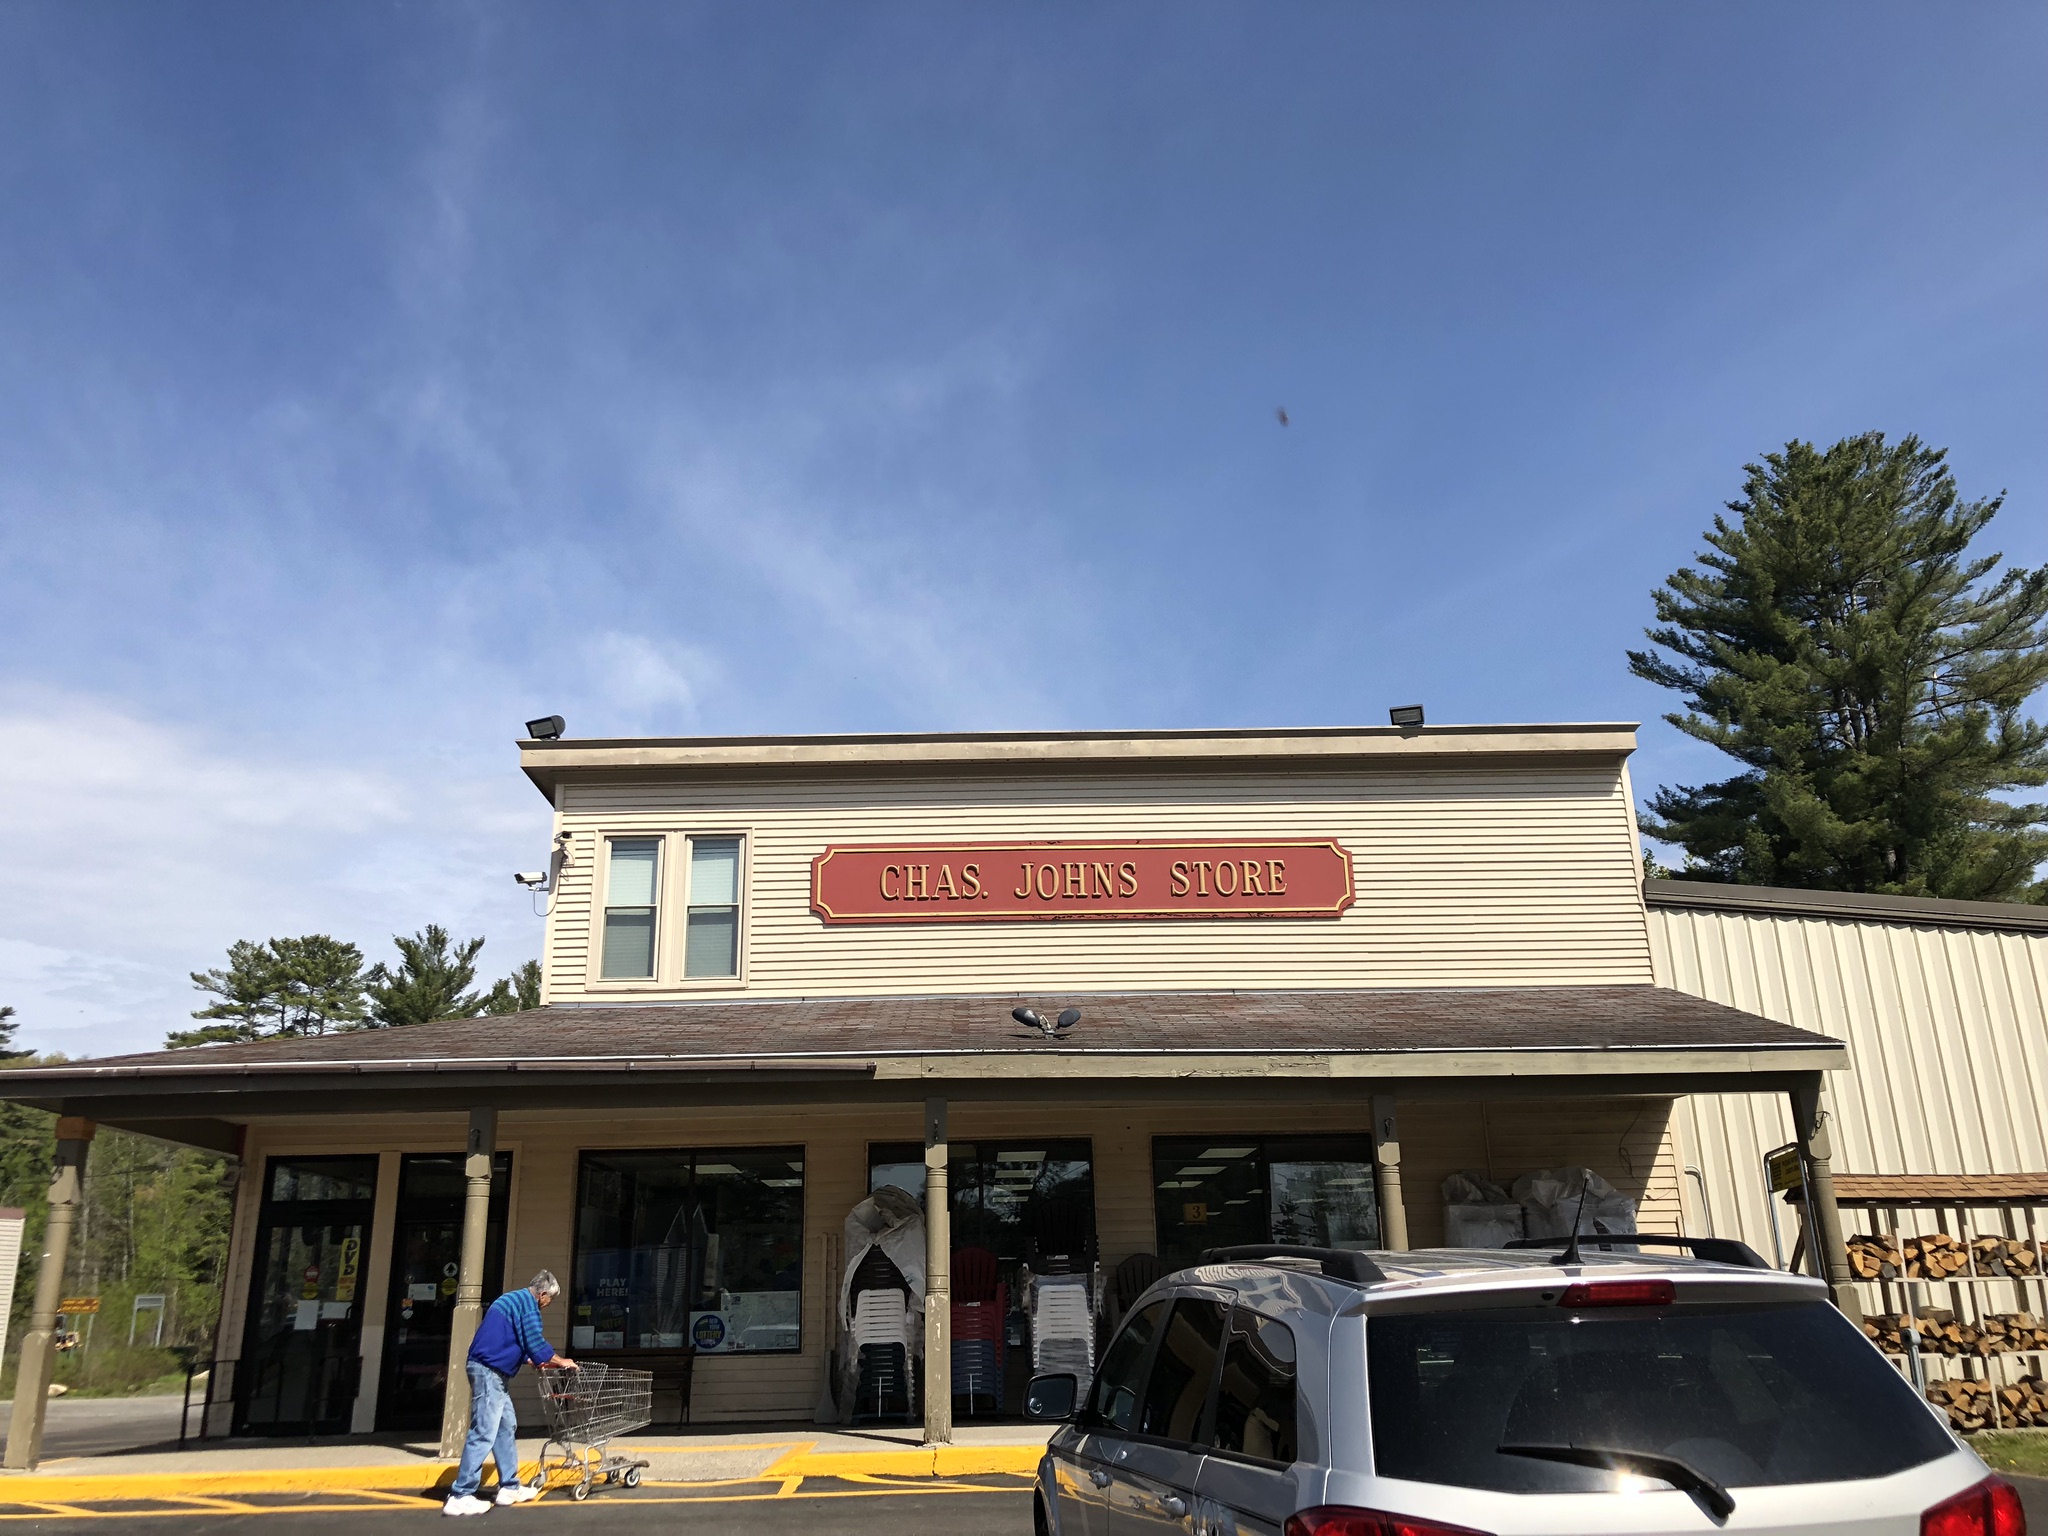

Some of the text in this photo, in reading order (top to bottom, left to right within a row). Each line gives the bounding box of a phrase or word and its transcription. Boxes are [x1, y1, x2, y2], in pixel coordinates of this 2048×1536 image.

[880, 859, 1288, 900] CHAS. JOHNS STORE
[1192, 1205, 1201, 1219] 3
[343, 1239, 357, 1276] DVD
[599, 1278, 627, 1287] PLAY
[596, 1287, 629, 1297] HERE!
